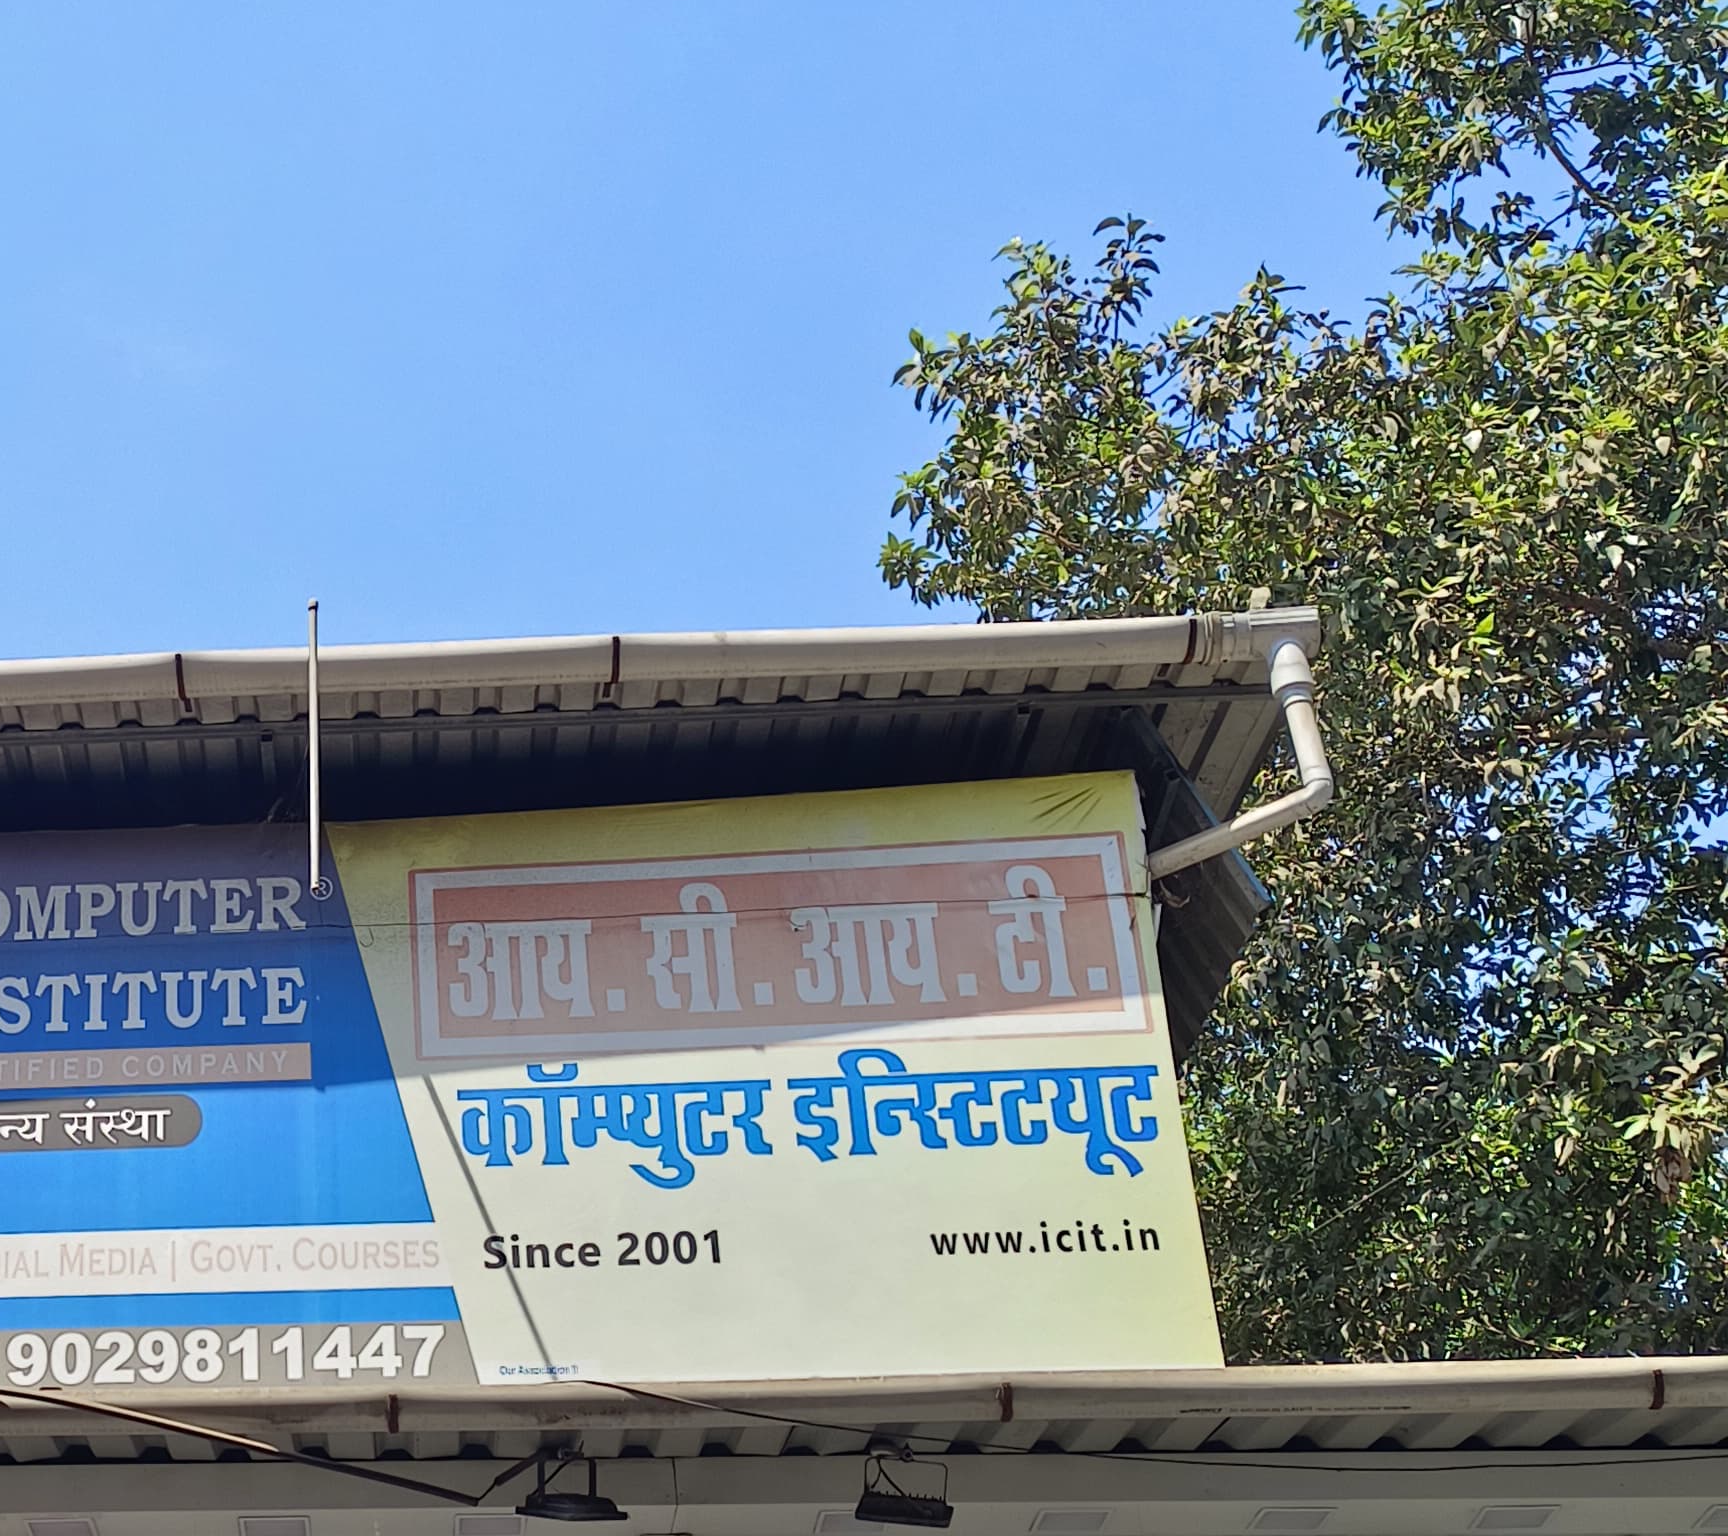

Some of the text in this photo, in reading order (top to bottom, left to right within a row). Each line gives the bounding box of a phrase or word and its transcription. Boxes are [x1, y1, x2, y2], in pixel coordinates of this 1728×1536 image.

[121, 1049, 289, 1078] COMPANY
[59, 1098, 172, 1148] संस्था
[482, 1229, 723, 1271] Since 2001
[930, 1220, 1161, 1257] www.icit.in
[6, 1324, 447, 1387] 9029811447
